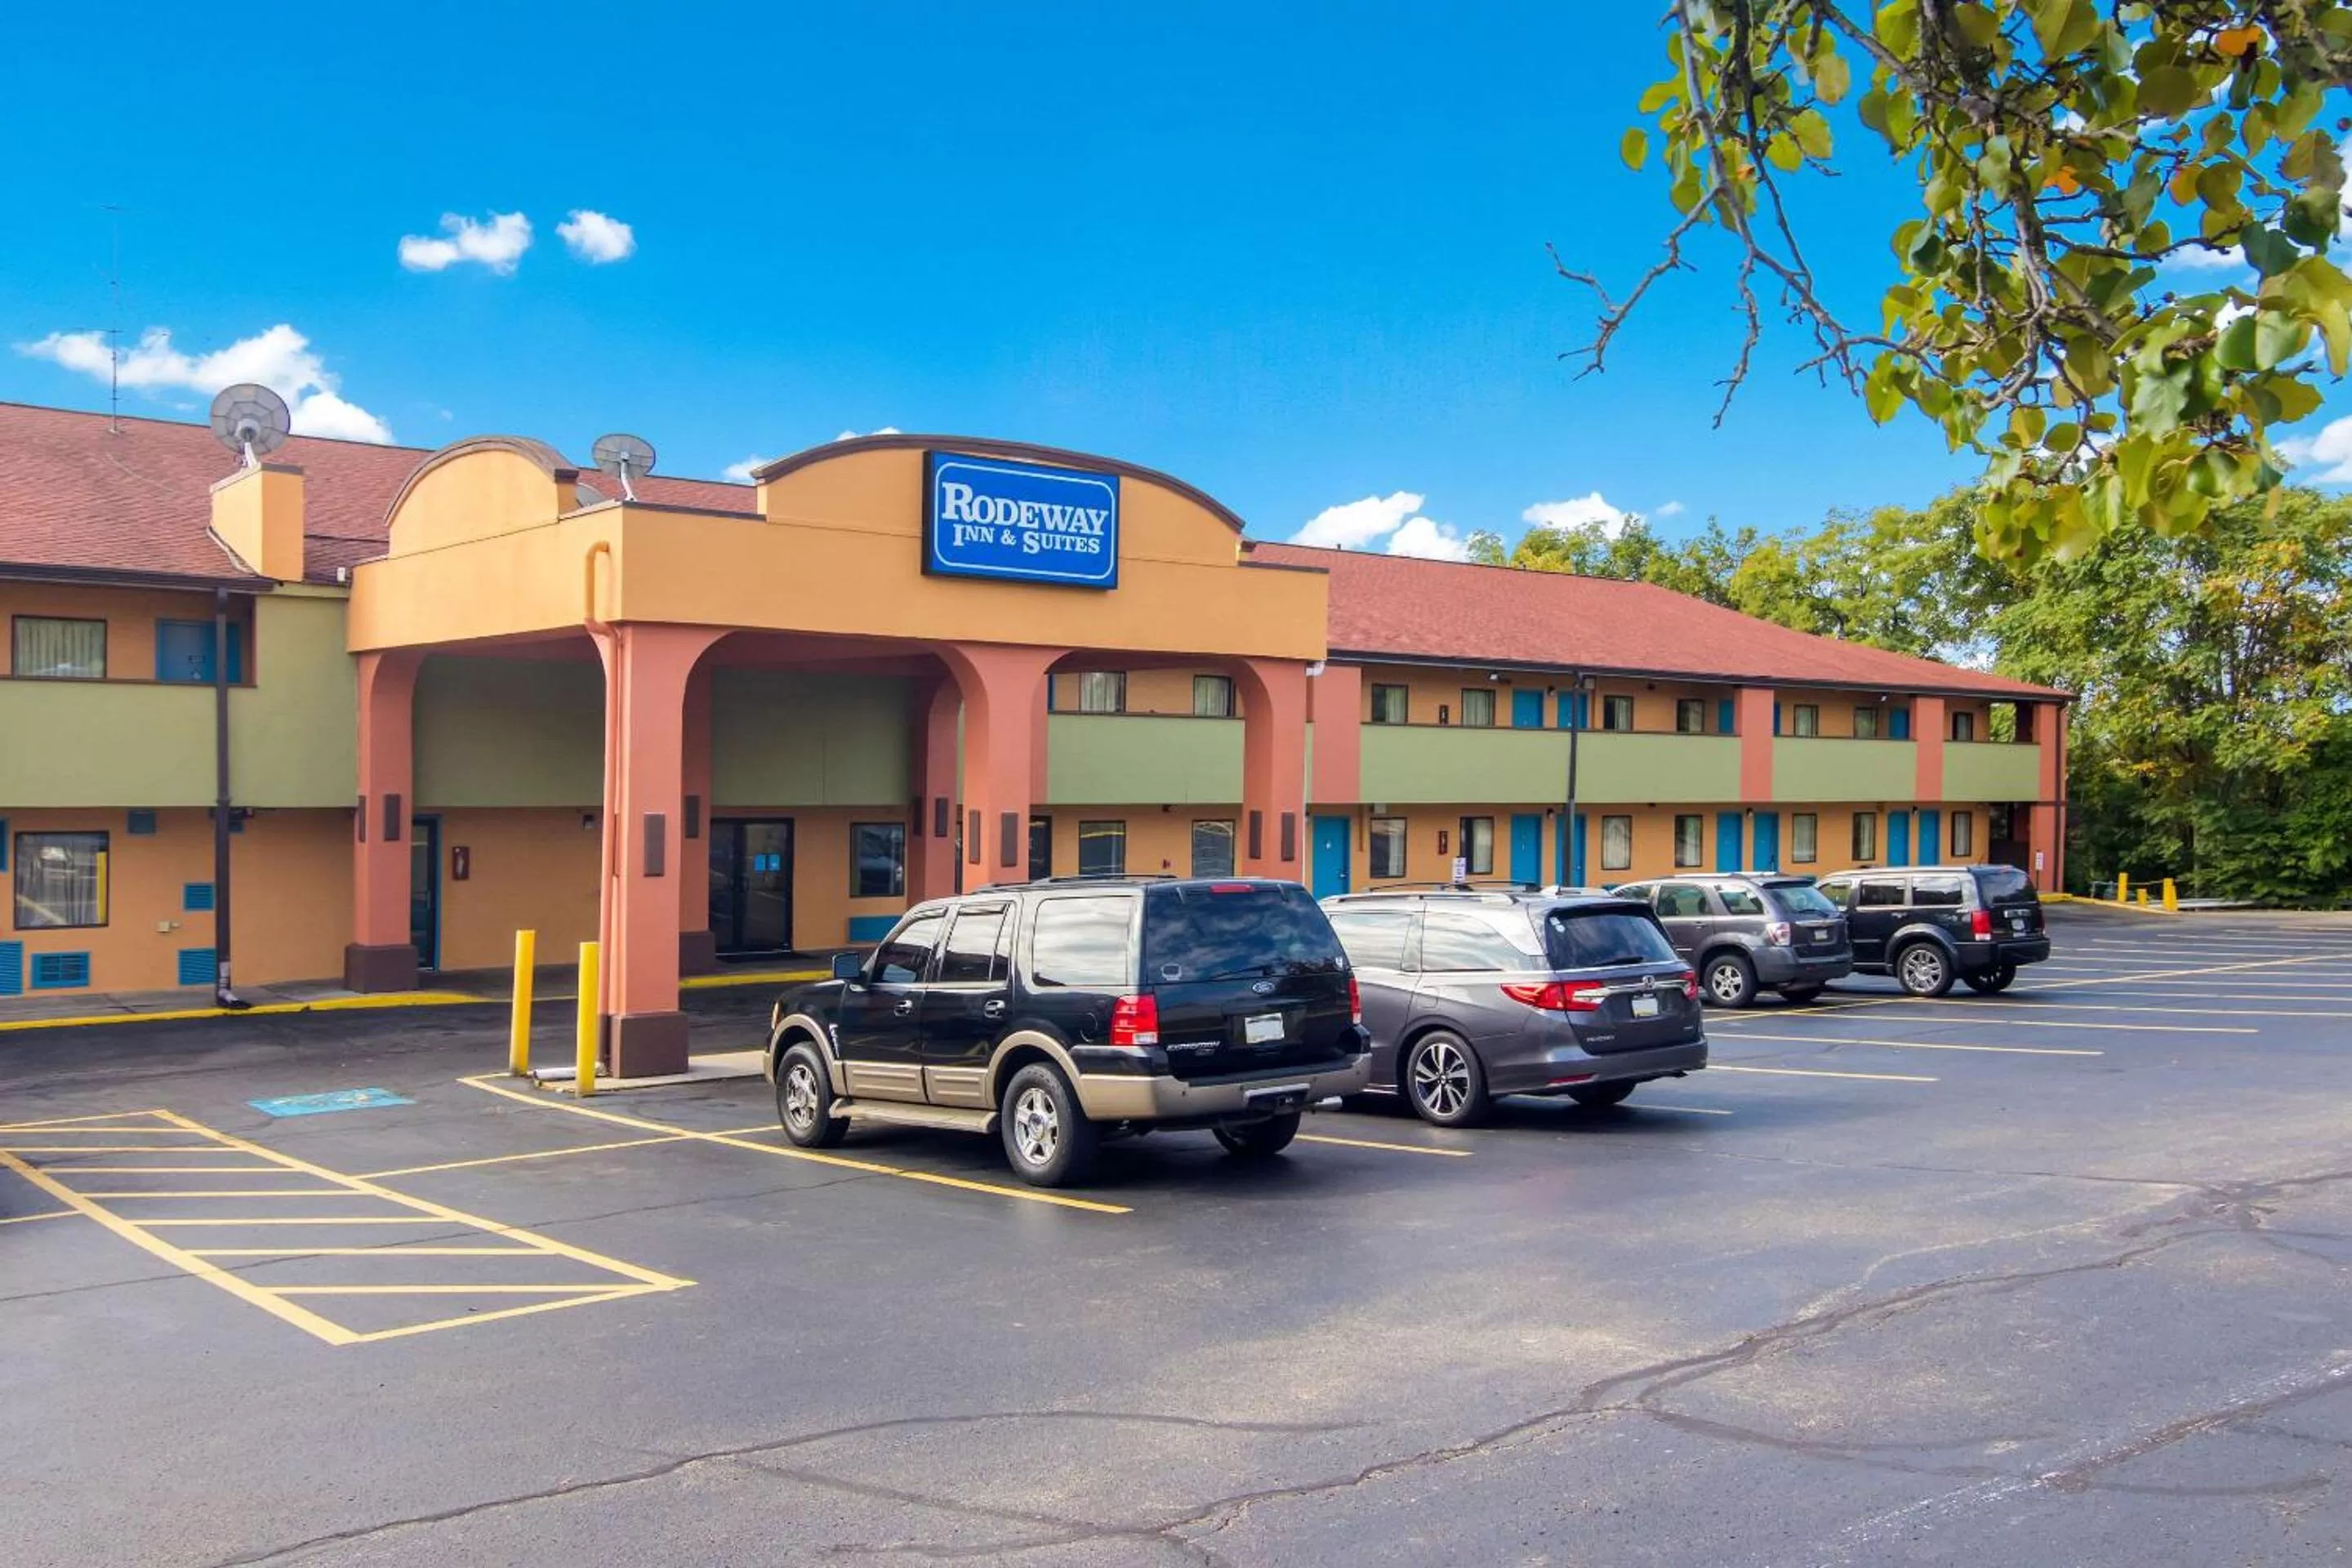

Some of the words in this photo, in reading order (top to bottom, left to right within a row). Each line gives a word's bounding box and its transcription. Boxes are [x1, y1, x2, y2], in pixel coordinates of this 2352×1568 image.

[942, 483, 1108, 536] RODEWAY
[953, 524, 994, 546] INN
[1000, 529, 1017, 546] &
[1022, 531, 1100, 555] SUITES
